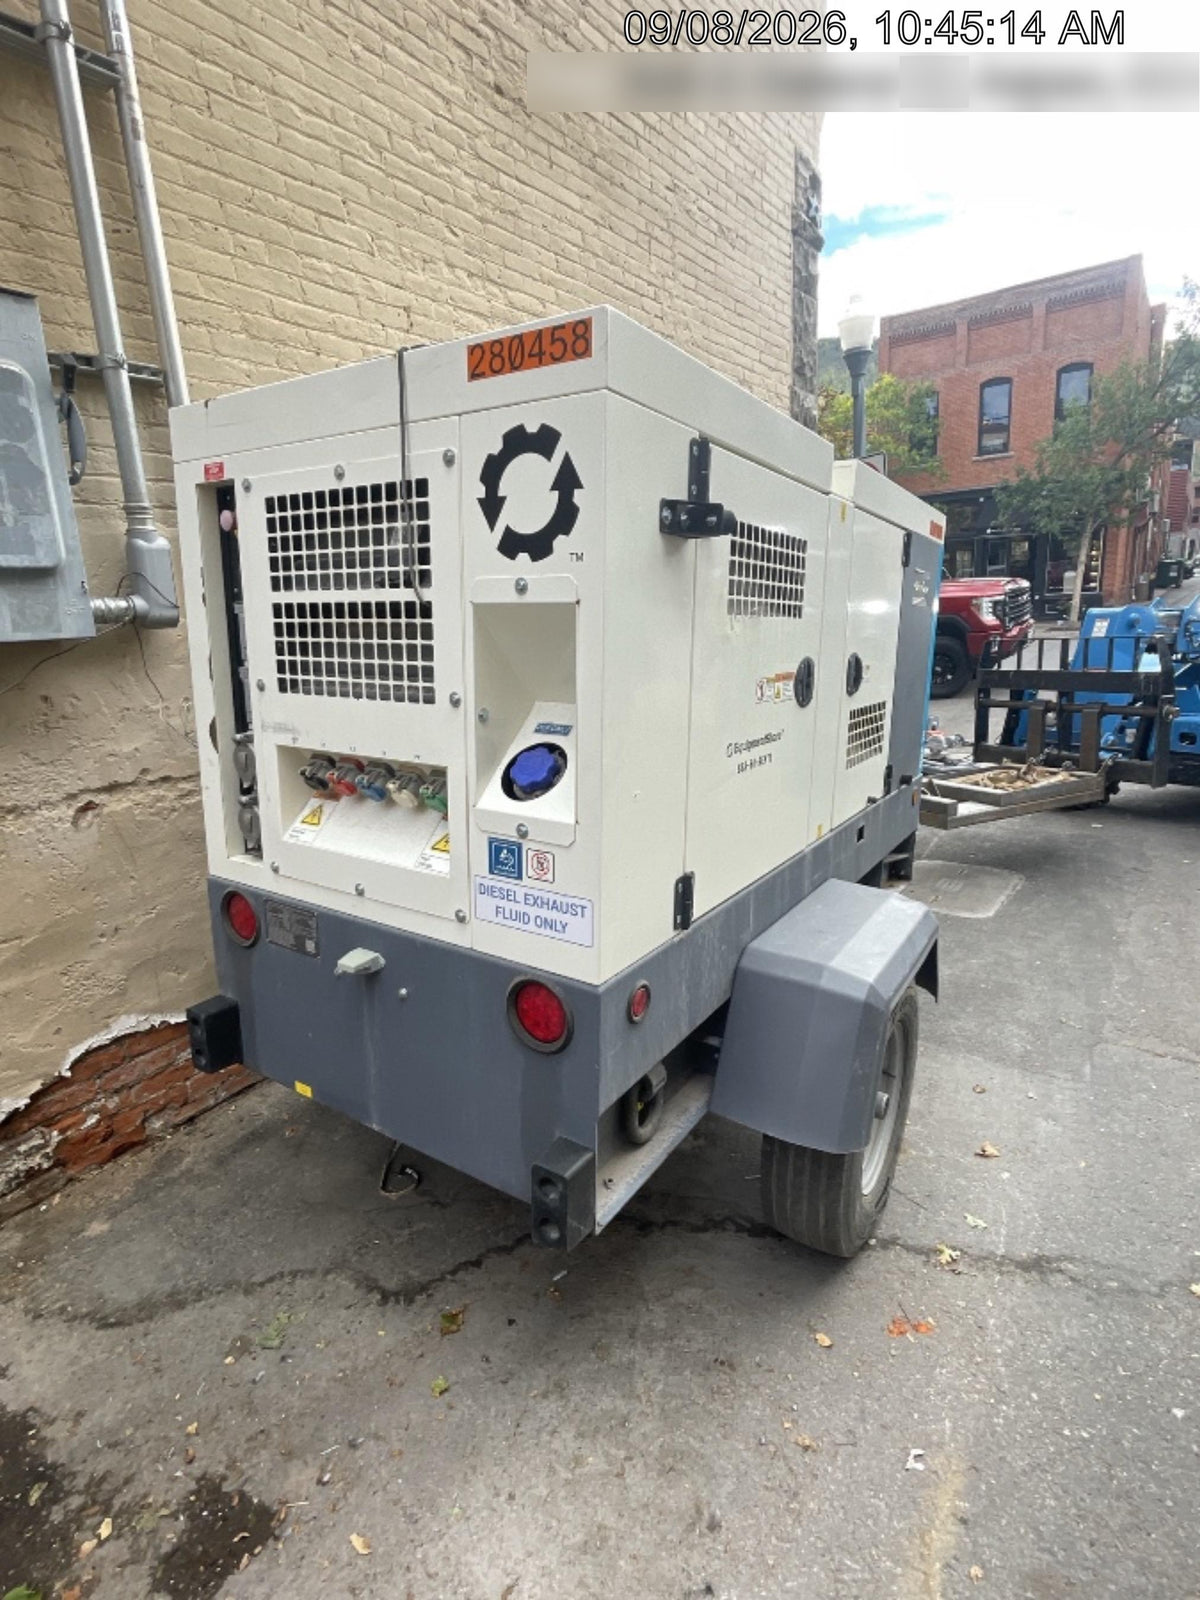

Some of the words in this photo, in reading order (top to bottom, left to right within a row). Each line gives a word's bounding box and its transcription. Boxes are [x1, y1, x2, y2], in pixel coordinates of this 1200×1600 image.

[470, 319, 590, 381] 280458
[478, 882, 521, 905] DIESEL
[523, 892, 588, 919] EXHAUST
[495, 906, 531, 926] FLUID
[534, 914, 569, 934] ONLY
